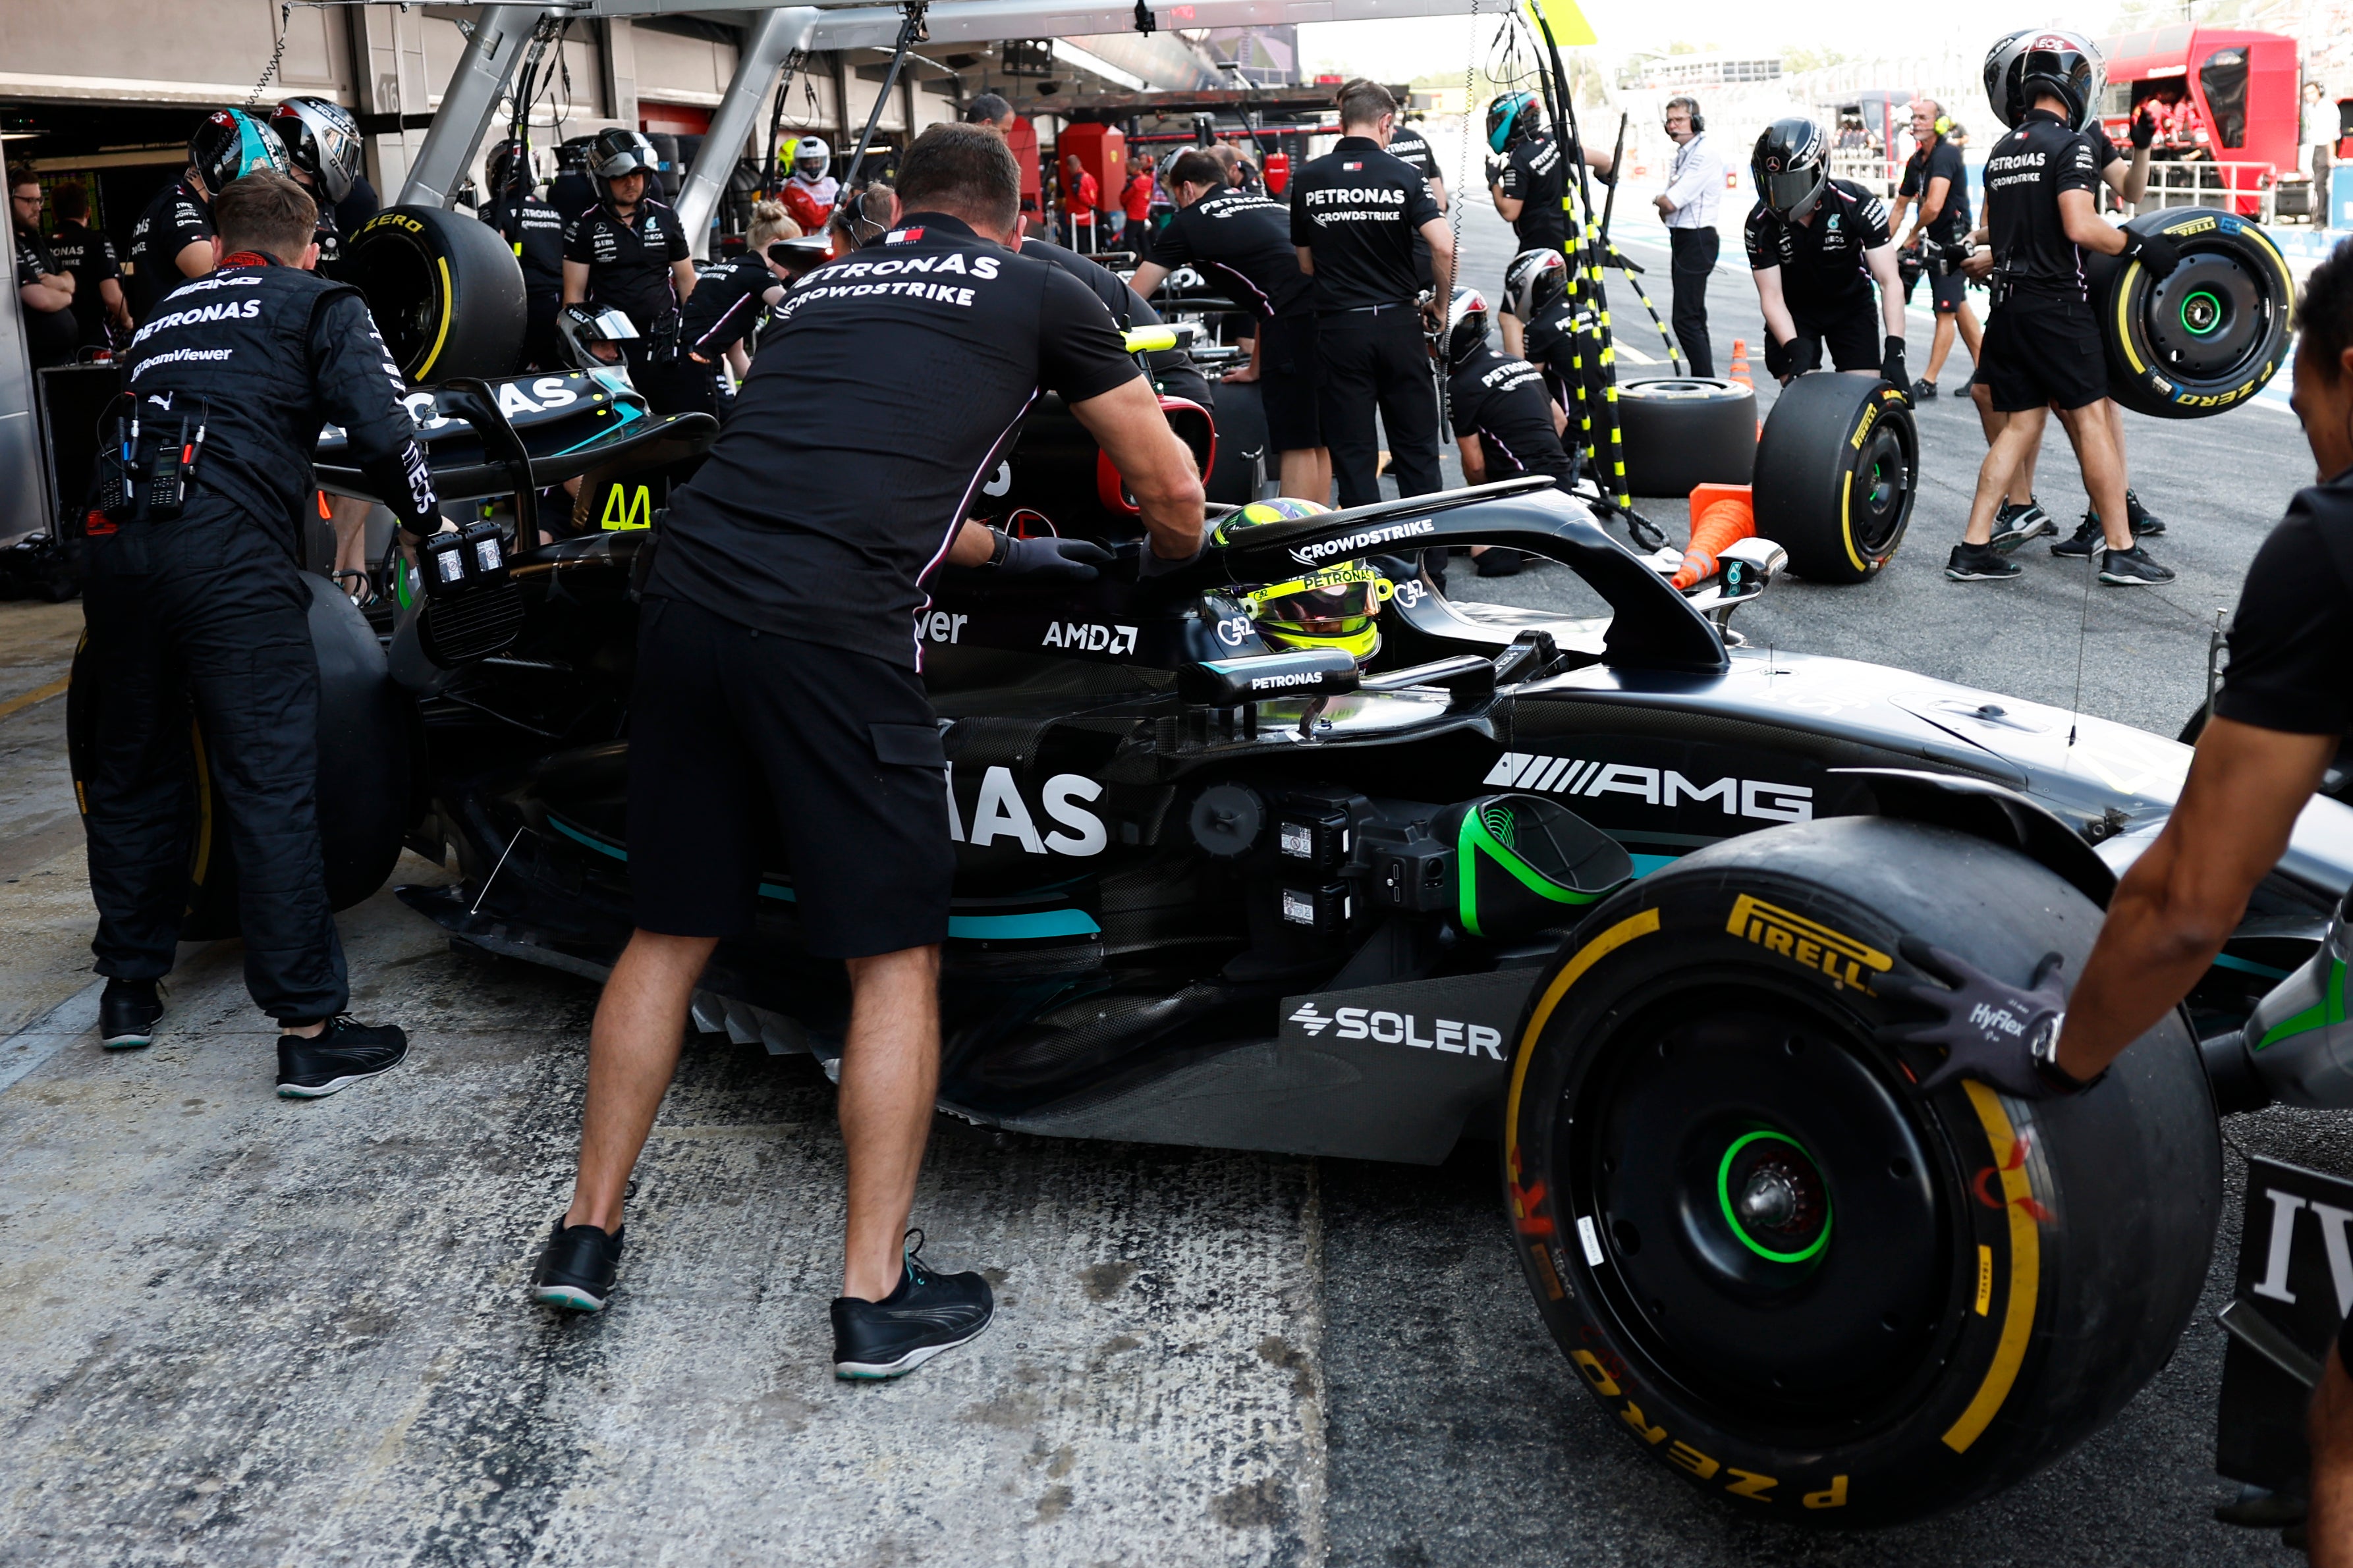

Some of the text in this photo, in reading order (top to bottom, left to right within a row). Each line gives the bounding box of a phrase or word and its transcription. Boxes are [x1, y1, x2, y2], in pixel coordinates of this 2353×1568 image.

[316, 103, 350, 134] SOLERA
[263, 133, 285, 175] SOLER
[1384, 139, 1426, 154] ETRONAS
[1988, 153, 2046, 172] PETRONAS
[1306, 188, 1405, 207] PETRONAS
[364, 213, 424, 232] ZERO
[1318, 211, 1400, 222] CROWDSTRIKE
[190, 277, 263, 293] AMG
[794, 253, 1001, 288] ETRONAS
[785, 282, 976, 312] CROWDSTRIKE
[131, 300, 262, 349] PETRONAS
[141, 348, 233, 371] TeamViewer
[2176, 379, 2255, 407] ZERO
[401, 440, 436, 514] INEOS
[601, 483, 651, 531] 44
[1299, 518, 1435, 560] CROWDSTRIKE
[1304, 570, 1371, 590] PETRONAS
[1042, 621, 1111, 651] AMD
[1252, 670, 1323, 691] PETRONAS
[1584, 763, 1813, 823] AMG
[1726, 892, 1894, 998] PIRELL
[1335, 1006, 1509, 1062] SOLER
[1969, 1002, 2026, 1037] HyFlex
[1571, 1349, 1848, 1509] P ZERO
